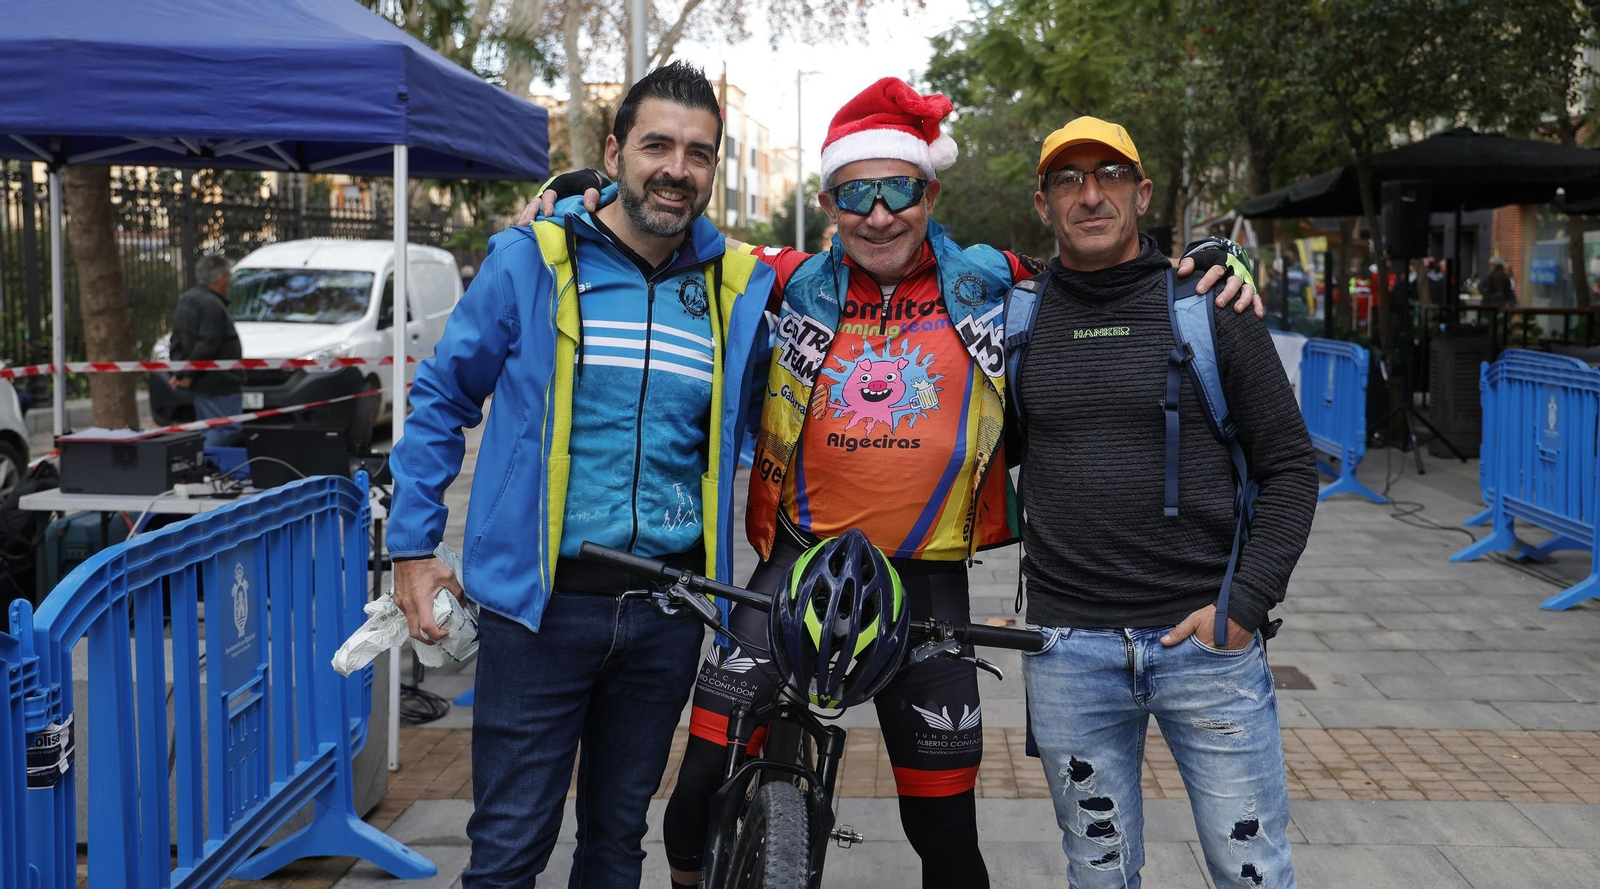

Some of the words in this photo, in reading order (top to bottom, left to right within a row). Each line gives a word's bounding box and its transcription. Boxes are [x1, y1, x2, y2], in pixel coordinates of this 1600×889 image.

[843, 297, 947, 321] omitos
[901, 318, 952, 334] team
[1073, 326, 1131, 340] HANKER
[783, 342, 819, 384] TEAM
[826, 432, 921, 453] Algeciras
[708, 677, 756, 698] CONTADOR
[916, 738, 949, 747] ALBERTO
